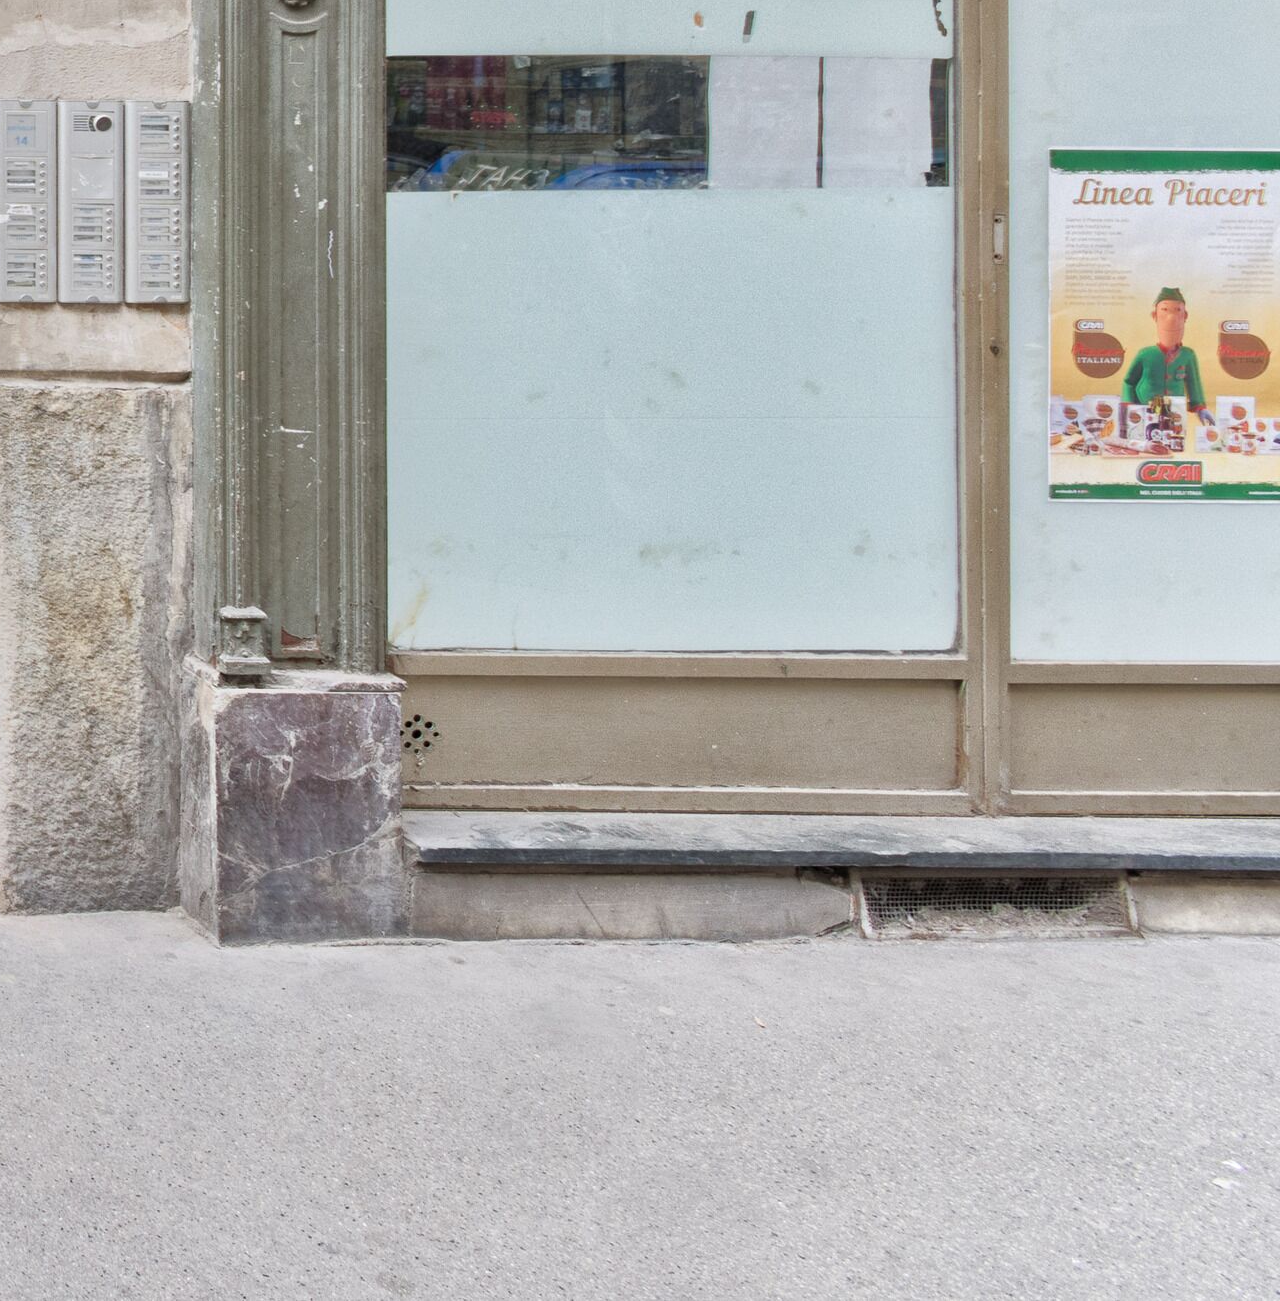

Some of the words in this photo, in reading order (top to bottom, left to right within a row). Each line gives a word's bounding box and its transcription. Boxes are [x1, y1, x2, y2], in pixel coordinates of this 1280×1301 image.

[1073, 178, 1154, 206] Linea
[1164, 179, 1269, 206] Piaceri
[1140, 464, 1202, 481] CRAI
